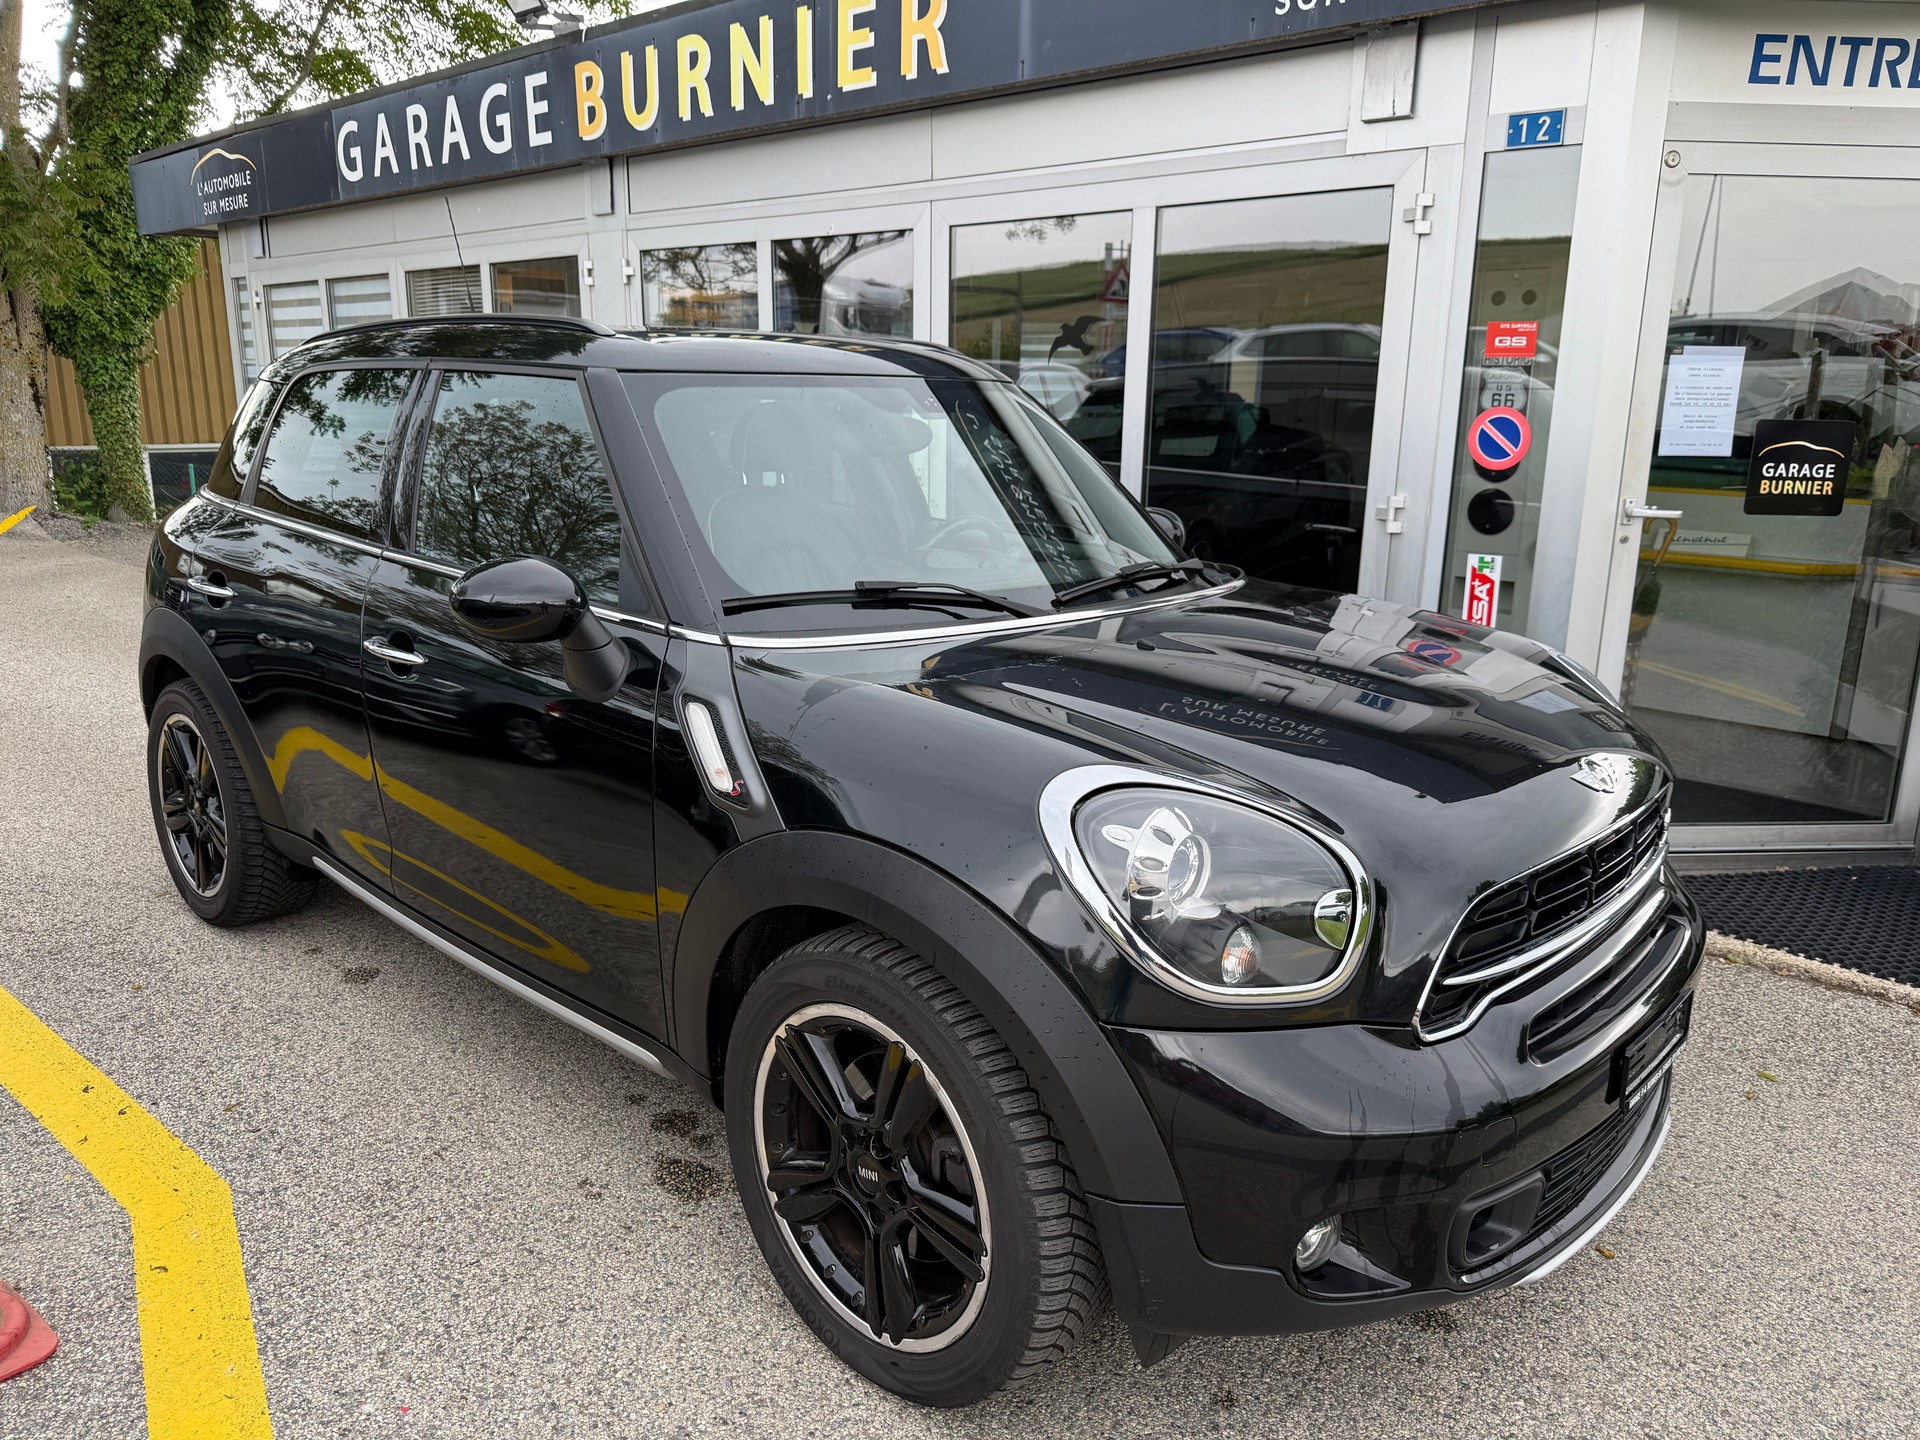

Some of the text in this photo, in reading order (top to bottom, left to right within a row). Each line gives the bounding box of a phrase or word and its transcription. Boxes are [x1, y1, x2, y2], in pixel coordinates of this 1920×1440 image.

[337, 0, 950, 183] GARAGE BURNIER
[1518, 115, 1551, 143] 12
[196, 170, 252, 196] L'AUTOMOBILE
[203, 193, 249, 216] SUR MESURE
[1494, 336, 1527, 347] GS
[1491, 393, 1515, 408] 66
[1762, 462, 1836, 478] GARAGE
[1759, 479, 1833, 495] BURNIER
[858, 1165, 879, 1182] MINI
[772, 1254, 842, 1354] YOKOHAMA
